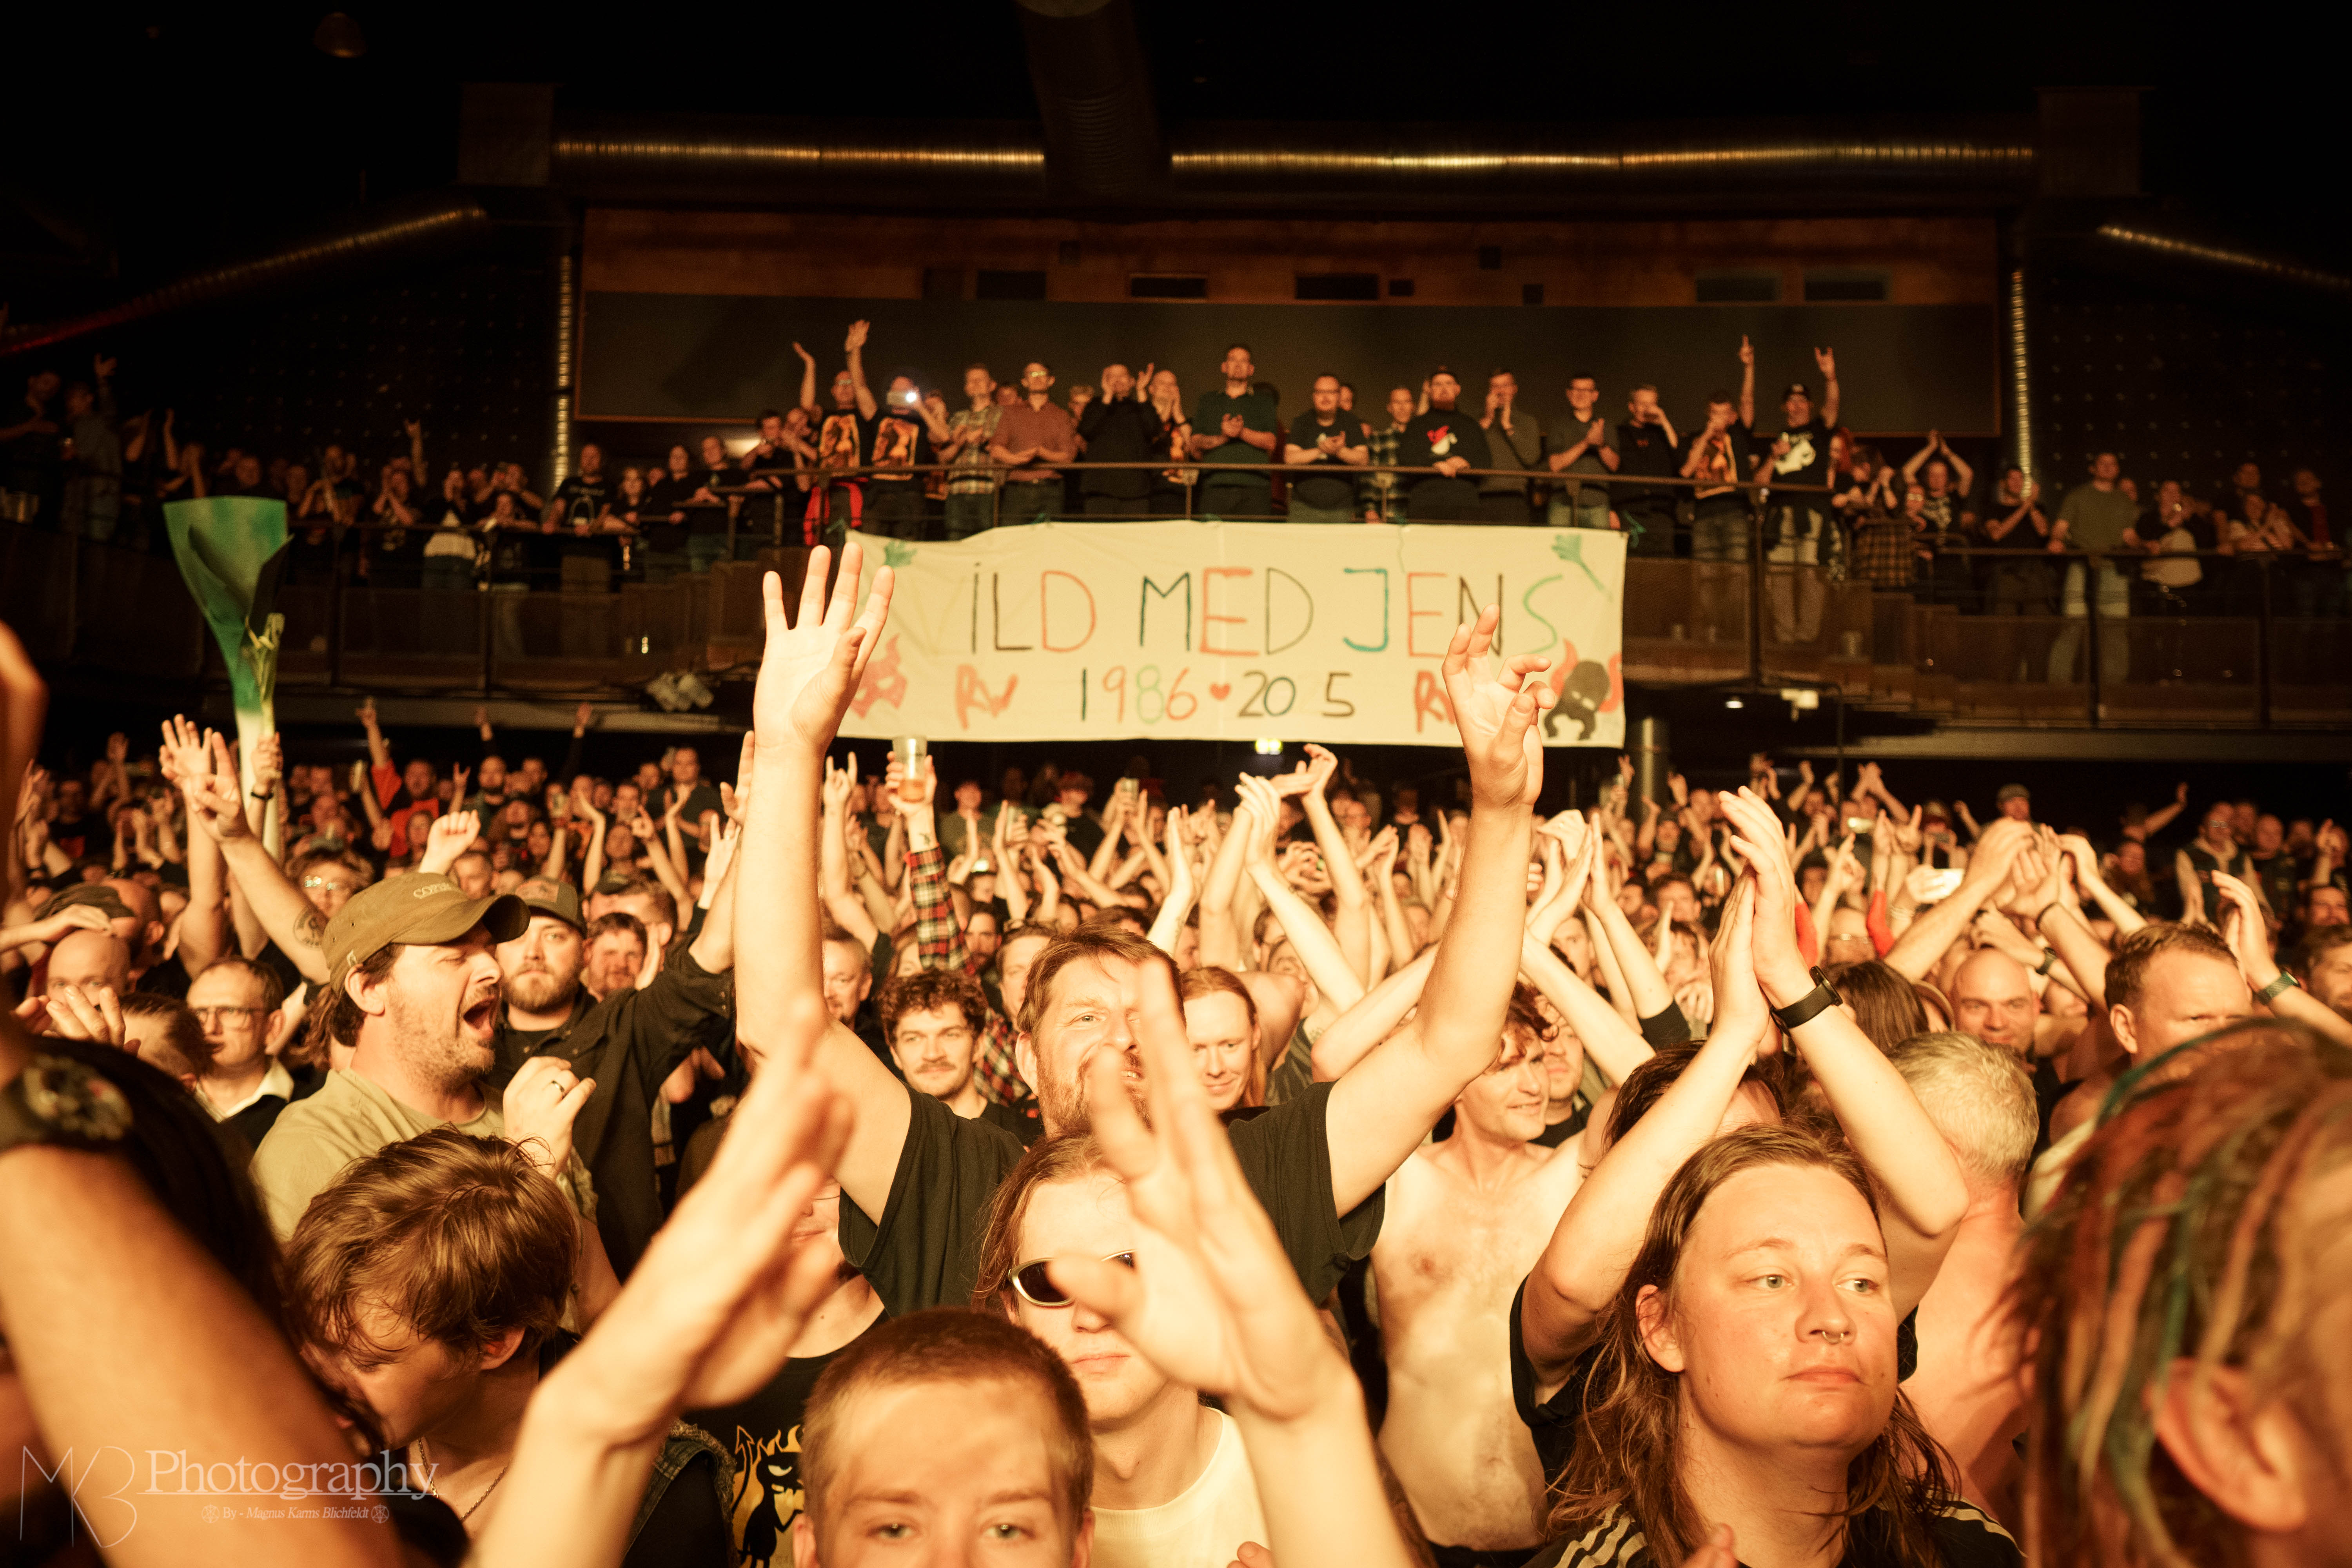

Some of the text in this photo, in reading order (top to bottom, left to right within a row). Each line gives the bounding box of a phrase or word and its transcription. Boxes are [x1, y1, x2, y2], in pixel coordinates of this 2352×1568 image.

[1140, 567, 1314, 656] MED
[1344, 568, 1562, 657] JENS
[1082, 664, 1198, 724] 1986
